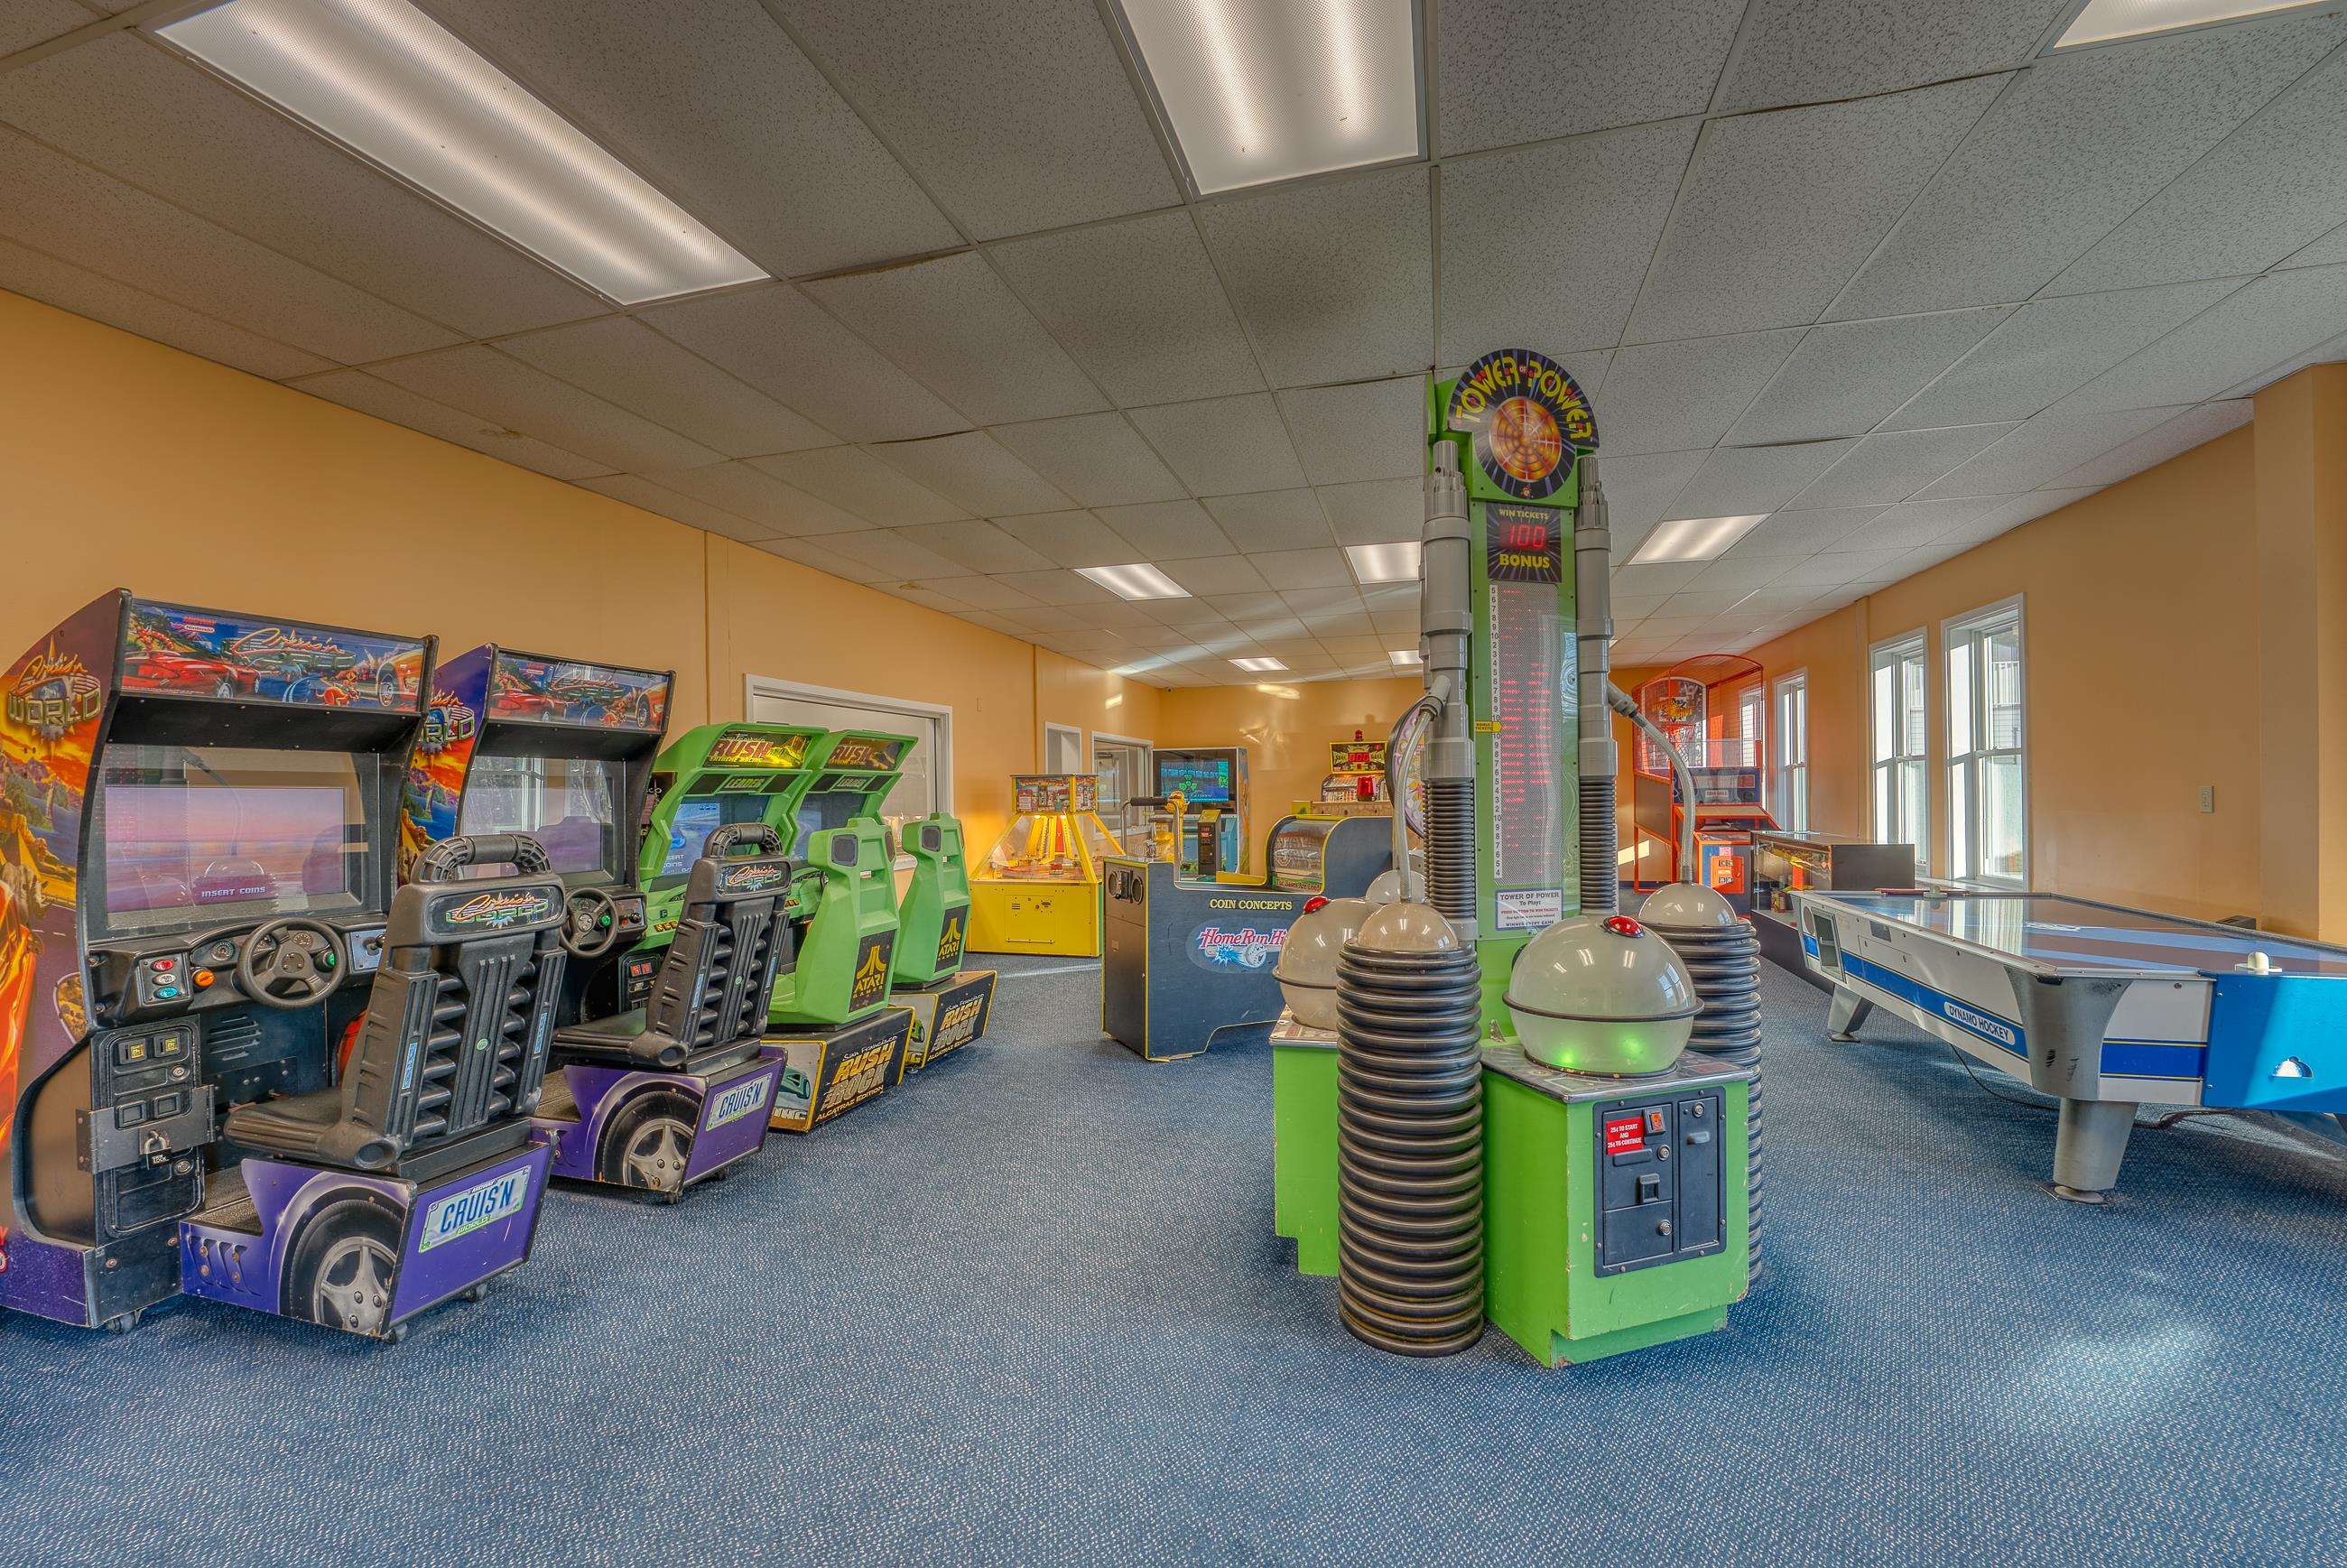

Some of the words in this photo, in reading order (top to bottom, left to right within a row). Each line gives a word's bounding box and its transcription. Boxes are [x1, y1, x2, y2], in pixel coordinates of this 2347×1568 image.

[1455, 356, 1521, 423] TOWER
[1527, 359, 1592, 439] POWER
[1498, 508, 1516, 517] WIN
[1517, 510, 1550, 520] TICKETS
[1508, 524, 1546, 549] 100
[1498, 552, 1551, 569] BONUS
[7, 686, 101, 726] WORLD
[422, 715, 476, 744] RLD
[710, 738, 775, 758] RUSH
[833, 745, 872, 761] RUSH
[723, 777, 765, 788] LEADER
[201, 888, 236, 897] INSERT
[239, 886, 265, 895] COINS
[454, 892, 539, 921] Cruis'n
[1210, 898, 1237, 909] COIN
[1238, 900, 1293, 911] CONCEPTS
[939, 941, 960, 957] ATARI
[1198, 927, 1241, 950] Home
[1242, 928, 1269, 946] Run
[852, 972, 885, 994] ATARI
[939, 997, 984, 1032] RUSH
[1948, 1004, 1978, 1027] DYNAMO
[1978, 1016, 2009, 1041] HOCKEY
[842, 1052, 859, 1062] San
[861, 1035, 898, 1053] Francisco
[832, 1040, 896, 1085] RUSH
[828, 1060, 890, 1109] ROCK
[719, 1081, 764, 1119] CRUIS'N
[815, 1099, 856, 1122] ALCATRAZ
[856, 1084, 884, 1102] EDITION
[1625, 1123, 1638, 1131] START
[1621, 1137, 1642, 1146] CONTINUE
[440, 1178, 515, 1233] CRUIS'N
